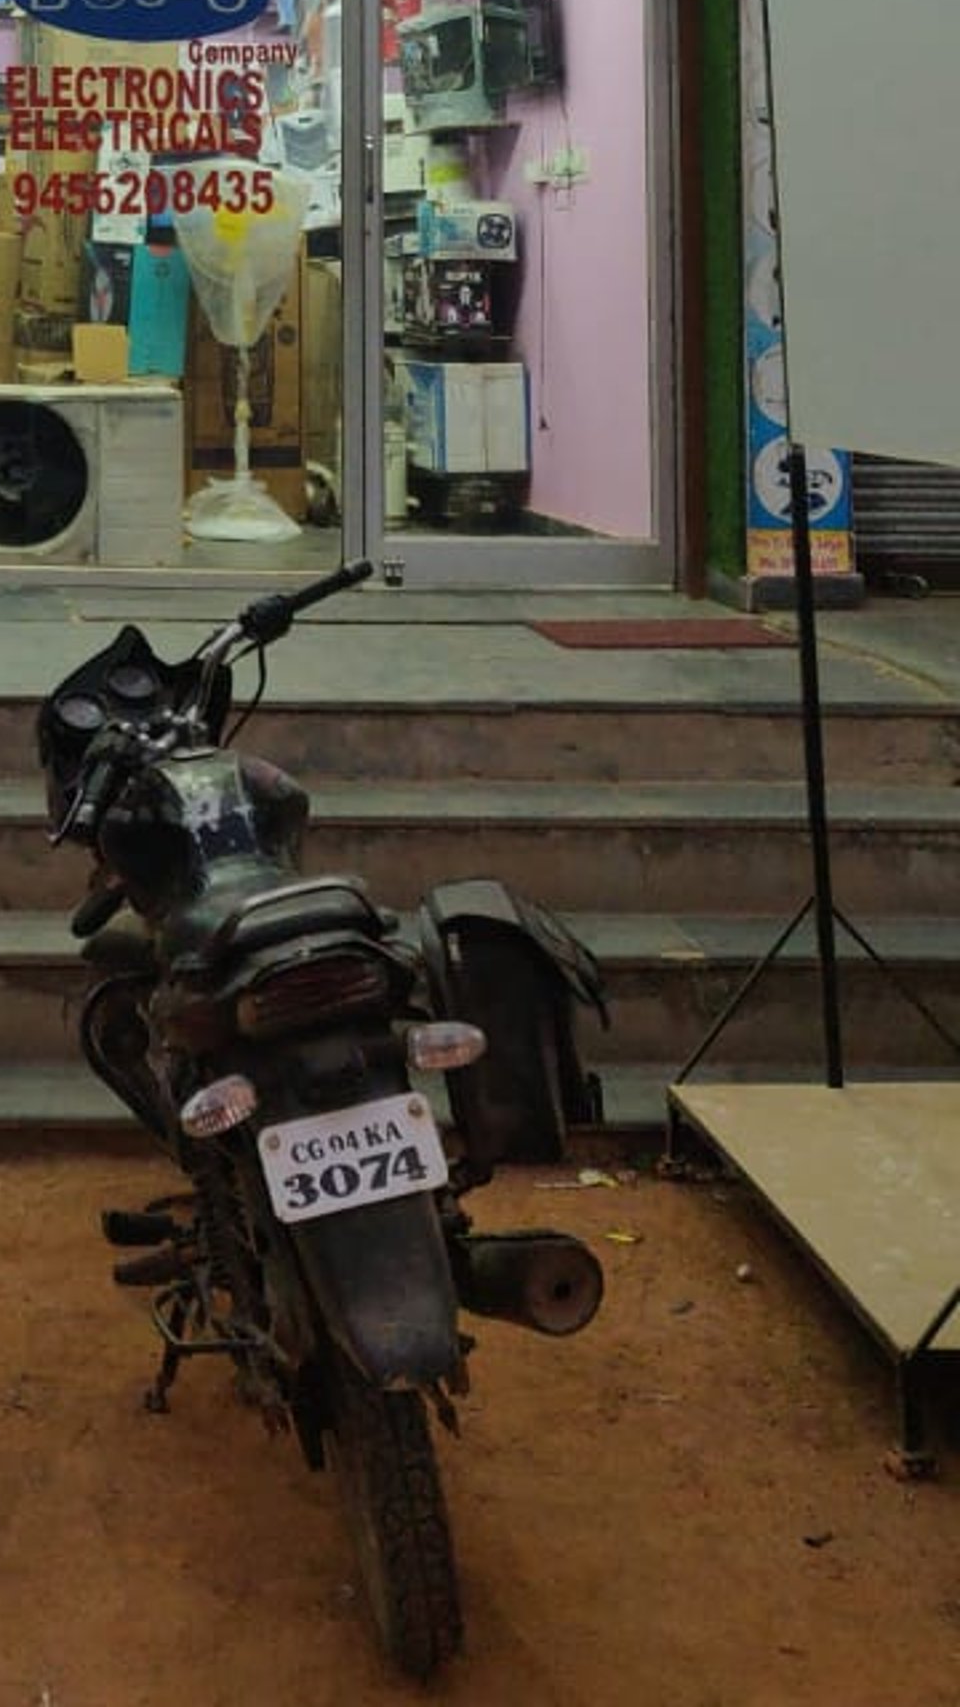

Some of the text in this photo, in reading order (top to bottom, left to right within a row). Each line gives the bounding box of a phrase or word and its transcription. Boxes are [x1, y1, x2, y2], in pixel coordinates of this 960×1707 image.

[187, 39, 299, 69] Company
[4, 66, 265, 110] ELECTRONICS
[9, 110, 265, 156] ELECTRICALS
[13, 170, 275, 216] 9456208435
[291, 1120, 404, 1164] CG 04 KA
[283, 1145, 428, 1209] 3074
